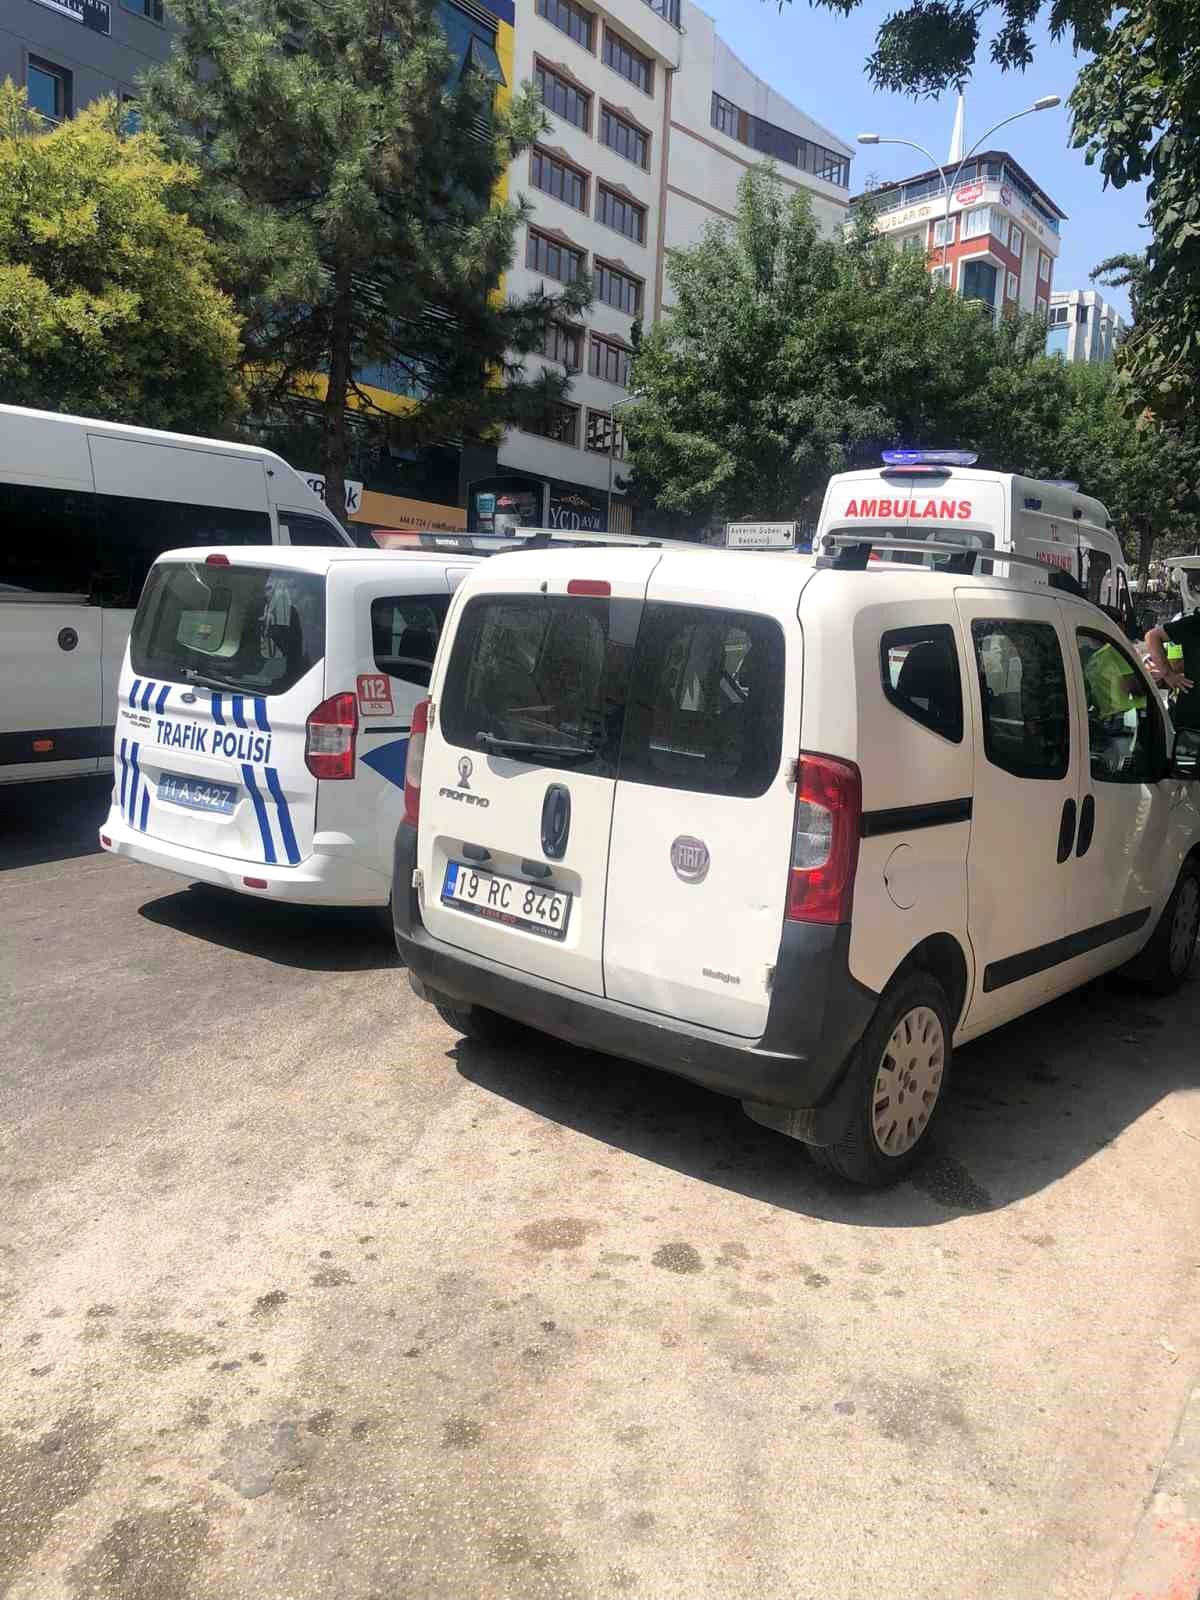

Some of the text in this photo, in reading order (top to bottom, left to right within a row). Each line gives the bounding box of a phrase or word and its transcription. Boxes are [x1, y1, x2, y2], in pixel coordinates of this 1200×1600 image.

[844, 499, 972, 519] AMBULANS
[361, 680, 385, 699] 112
[157, 720, 272, 763] TRAFİK POLİSİ
[165, 780, 231, 808] 11 A 5427
[459, 872, 479, 898] 19
[488, 880, 512, 908] RC
[523, 889, 562, 922] 846
